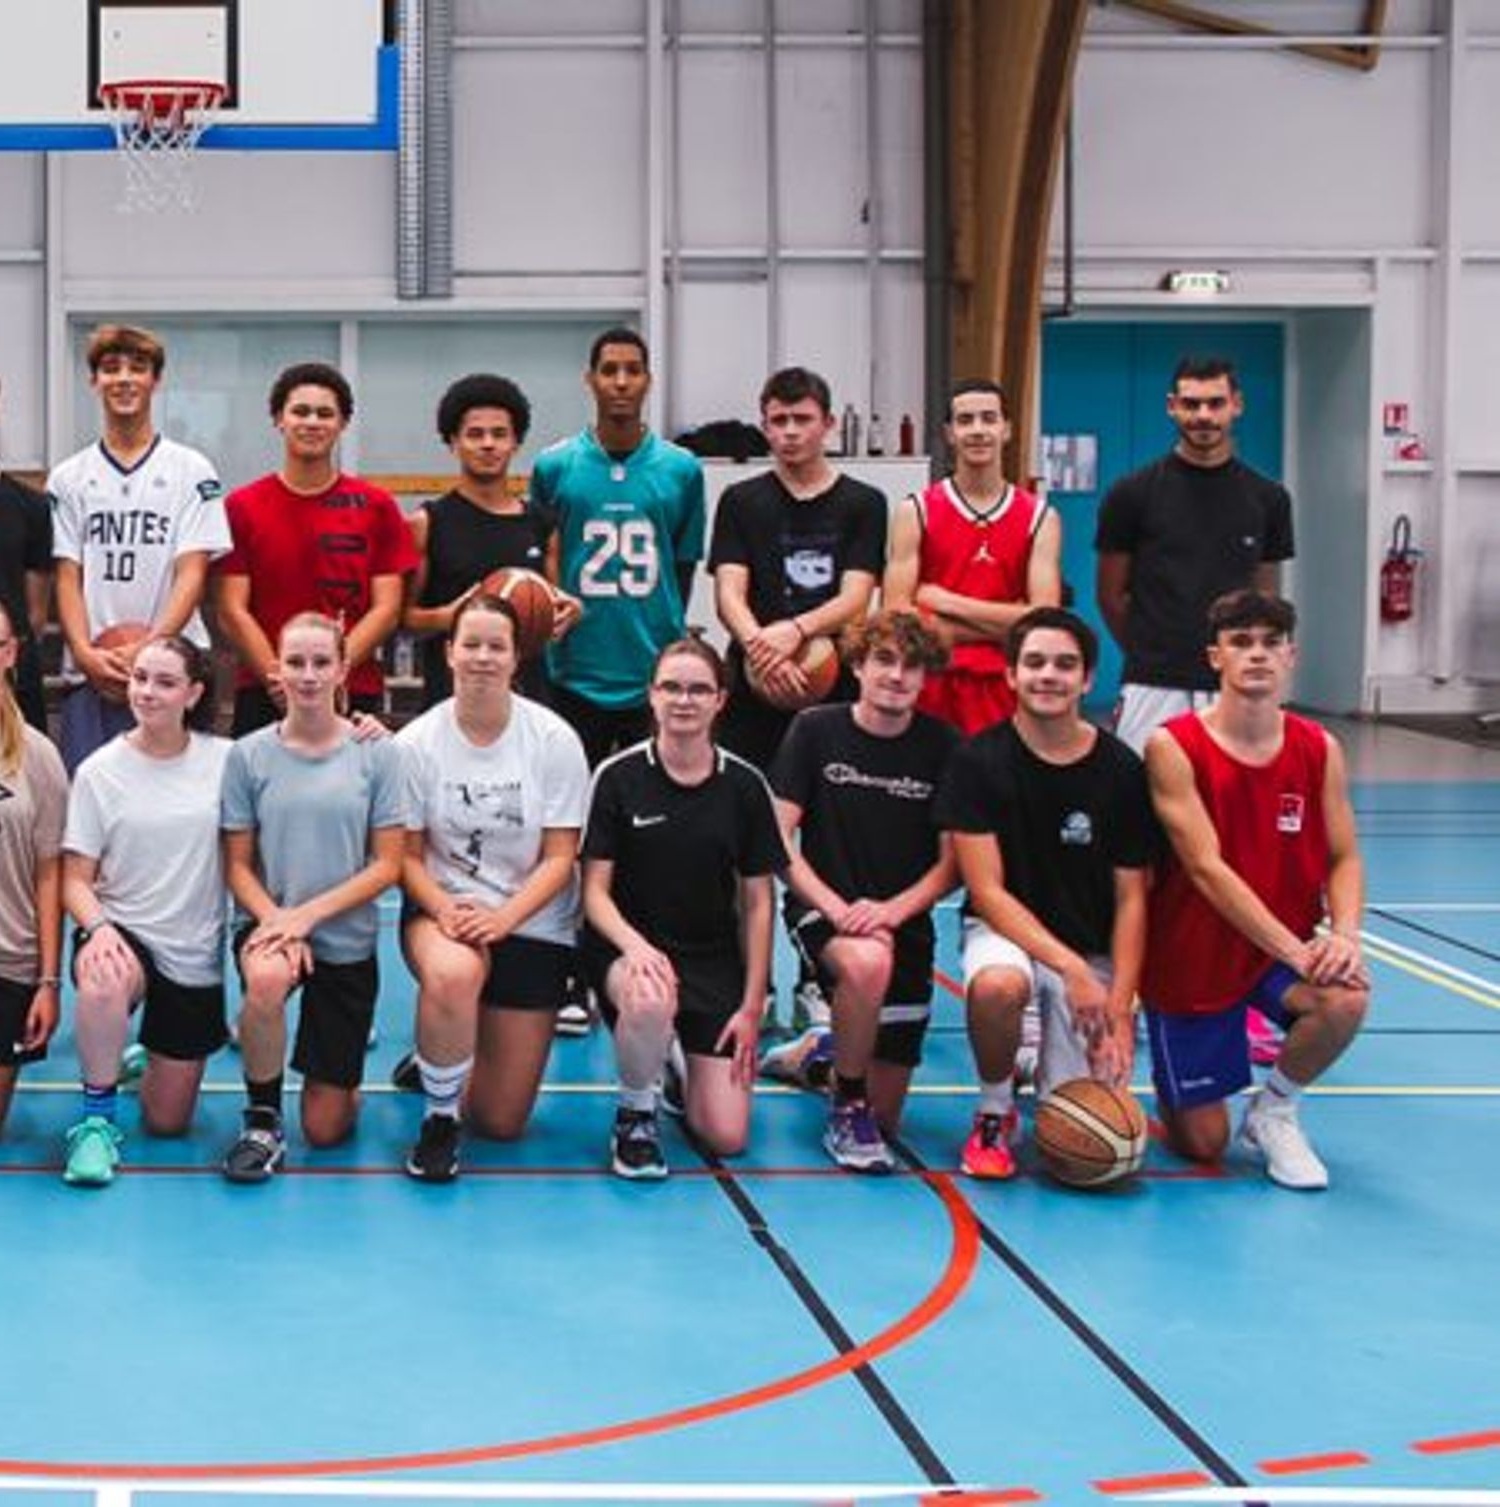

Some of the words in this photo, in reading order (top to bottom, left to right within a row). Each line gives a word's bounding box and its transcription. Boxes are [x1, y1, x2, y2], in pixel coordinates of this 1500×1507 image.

[82, 509, 171, 545] ANTES
[103, 551, 135, 582] 10
[580, 519, 658, 597] 29
